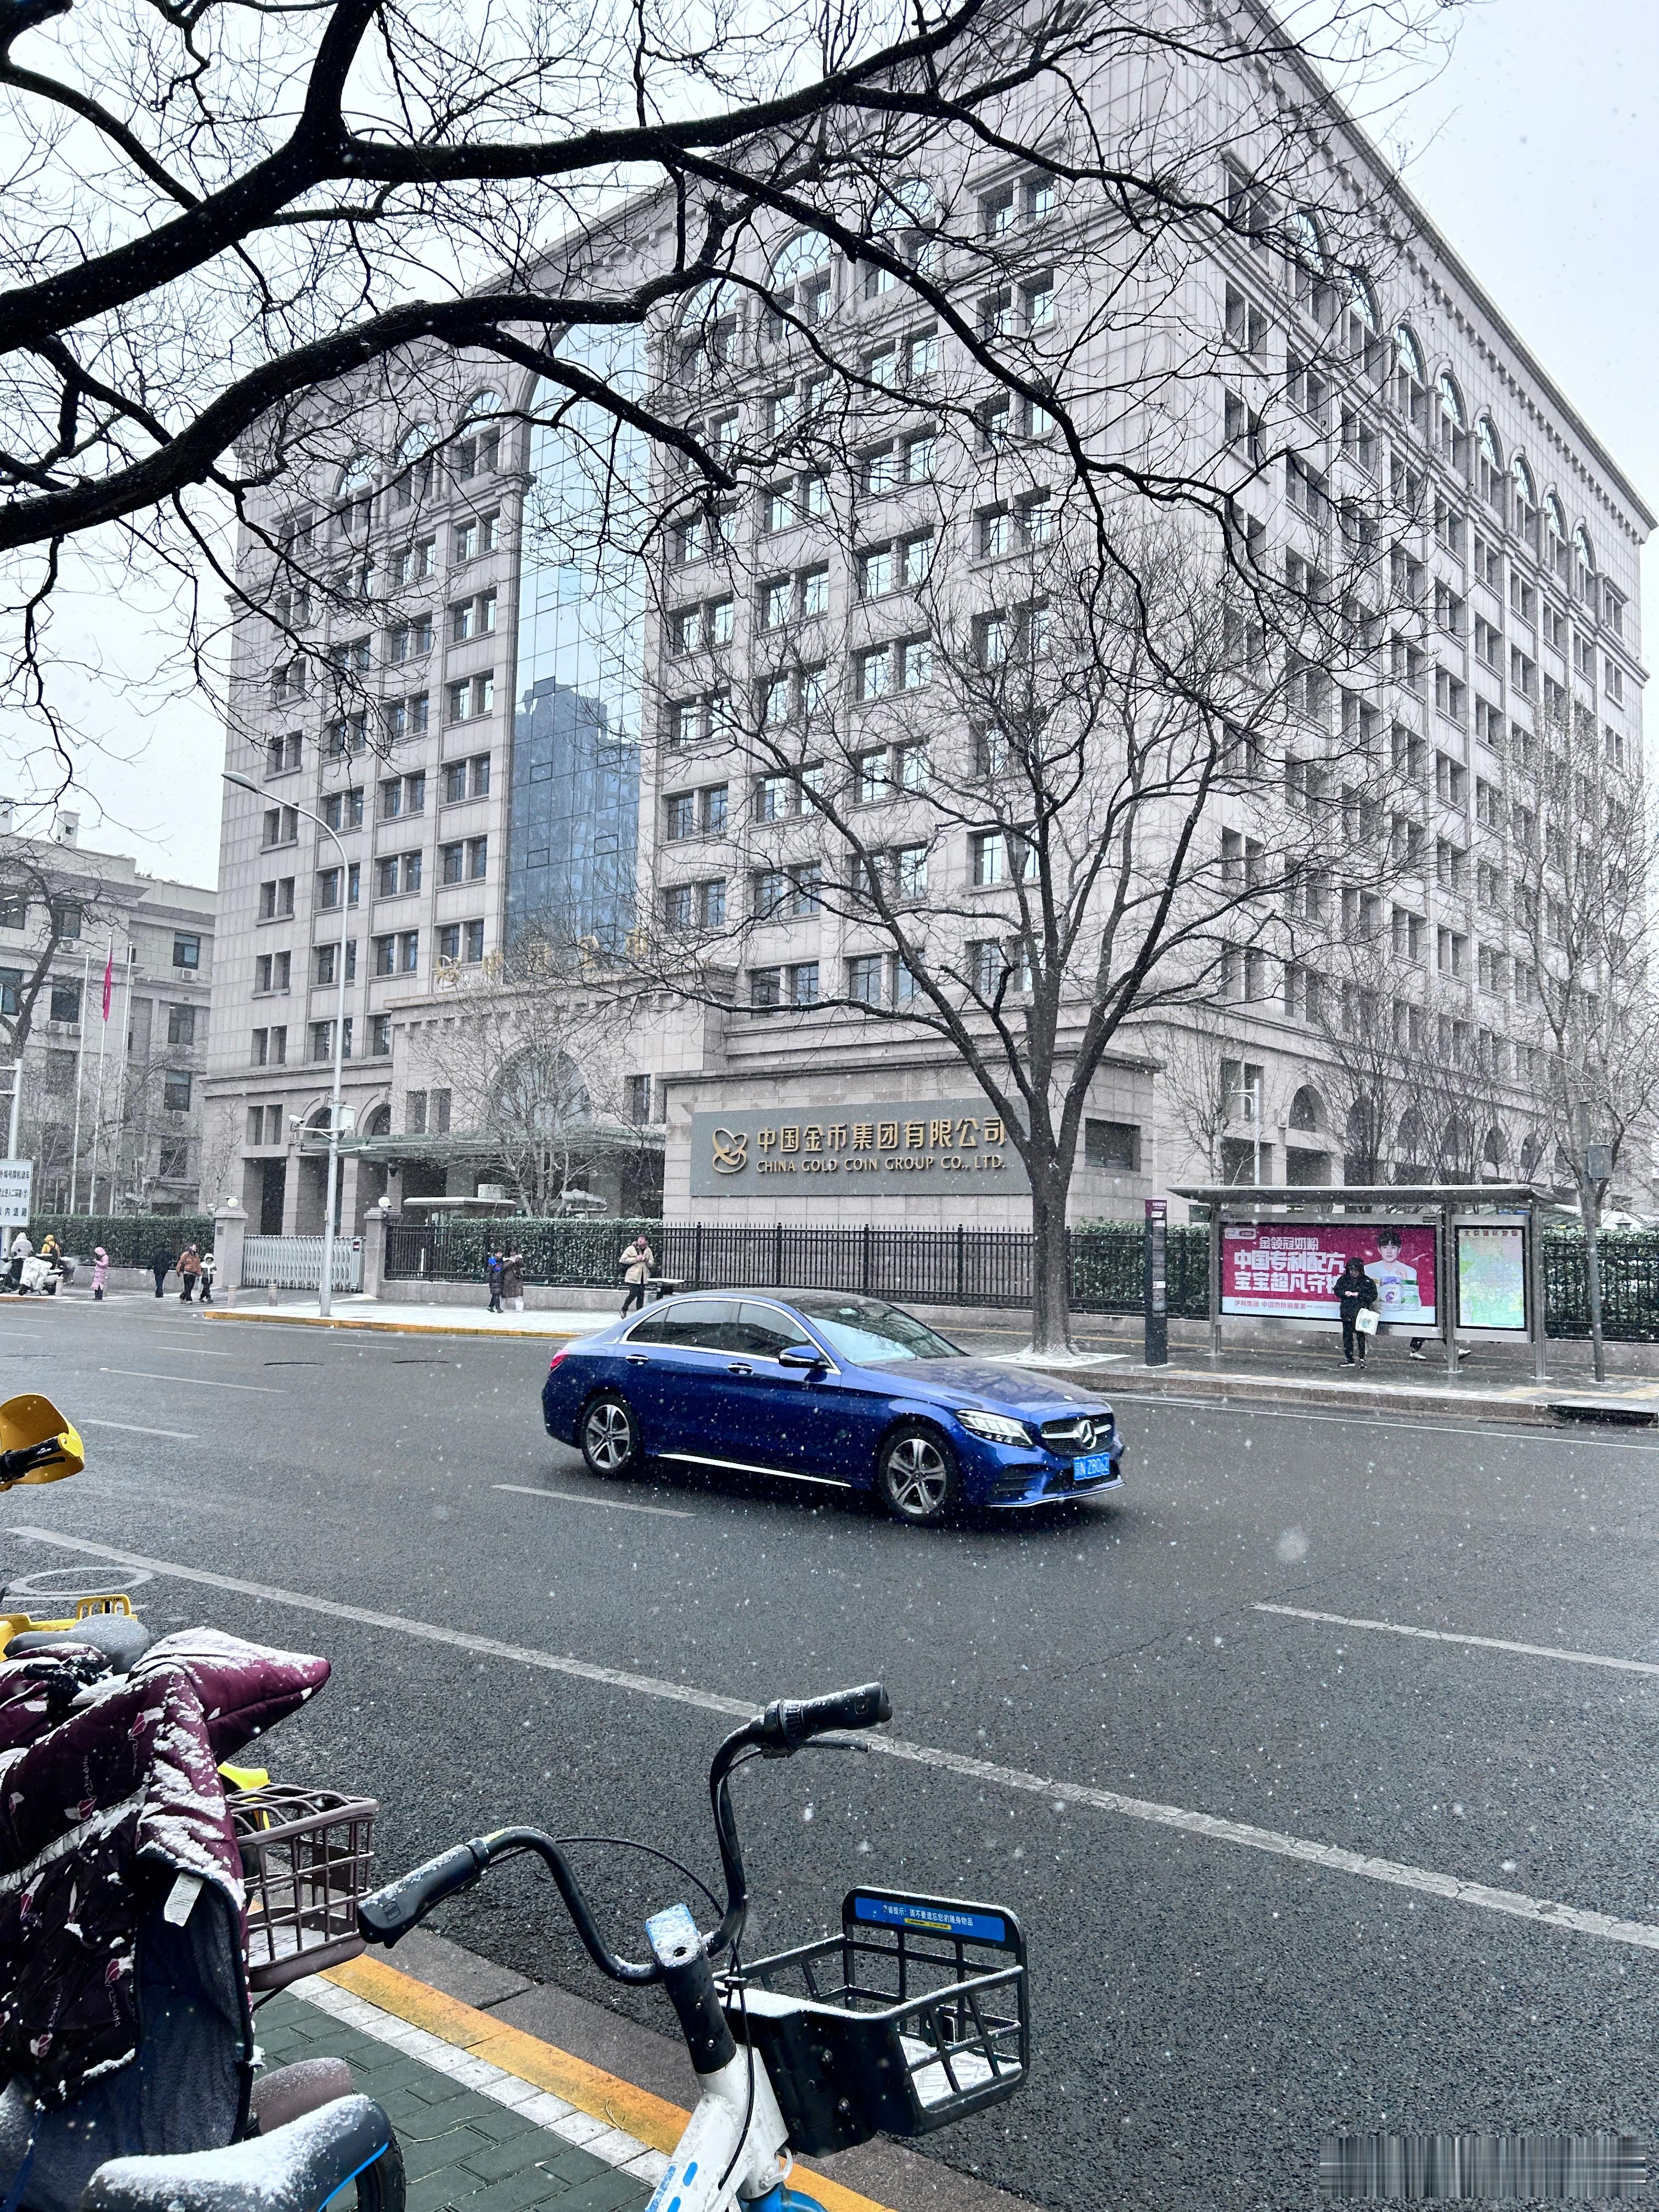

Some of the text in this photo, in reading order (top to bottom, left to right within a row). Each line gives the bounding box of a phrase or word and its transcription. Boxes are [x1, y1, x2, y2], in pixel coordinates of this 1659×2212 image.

[757, 1116, 1005, 1152] 中国金币集团有限公司
[757, 1159, 795, 1172] CHINA
[802, 1159, 838, 1172] GOLD
[844, 1158, 878, 1171] COIN
[885, 1156, 934, 1170] GROUP
[1259, 1237, 1319, 1250] 金领冠奶粉
[1234, 1249, 1345, 1273] 中国专利配方
